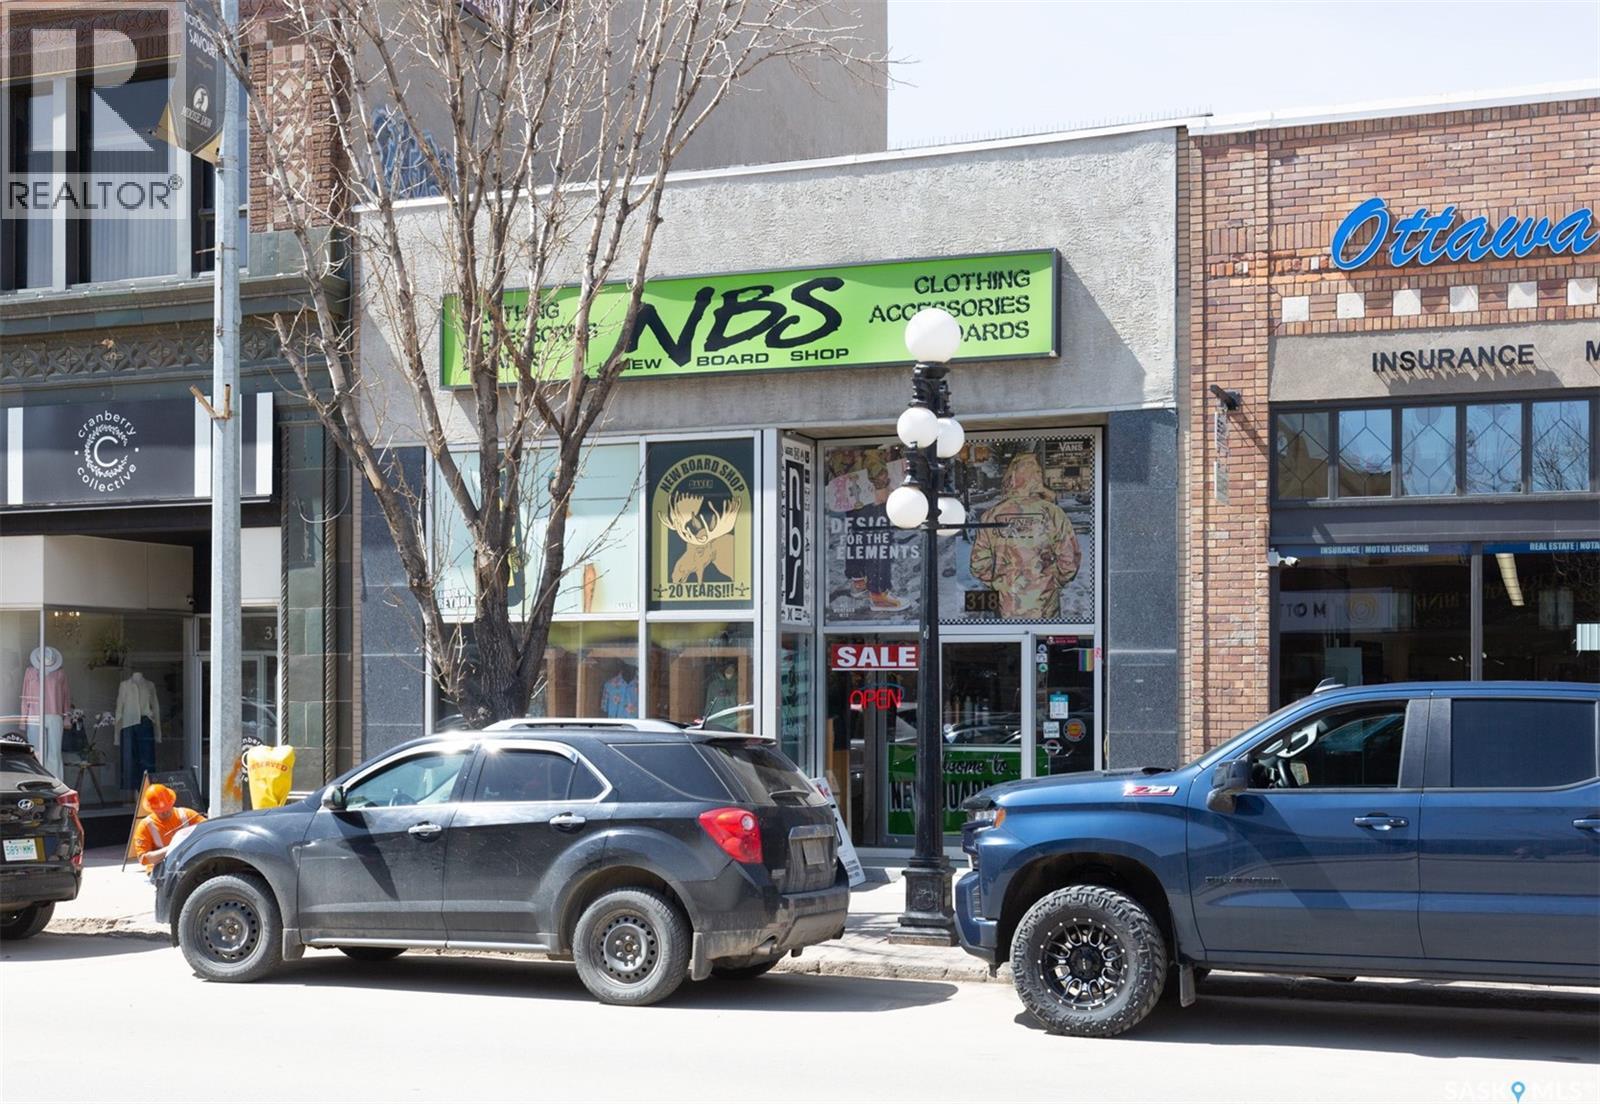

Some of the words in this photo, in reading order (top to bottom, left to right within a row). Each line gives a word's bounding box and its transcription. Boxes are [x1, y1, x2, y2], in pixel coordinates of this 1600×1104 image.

[1331, 197, 1600, 270] Ottawa
[914, 269, 1031, 295] CLOTHING
[868, 295, 1031, 324] ACCSORIES
[621, 277, 844, 367] NBS
[957, 320, 1030, 342] ARDS
[696, 353, 769, 367] BOARD
[790, 348, 849, 362] SHOP
[1371, 343, 1536, 373] INSURANCE
[78, 410, 136, 438] cranberry
[77, 464, 137, 492] collective
[660, 467, 683, 494] NEW
[681, 458, 720, 475] BOARD
[719, 464, 745, 493] SHOP
[830, 516, 889, 534] DESIG
[840, 535, 863, 545] FOR
[867, 532, 891, 544] THE
[1529, 542, 1548, 551] REAL
[1548, 541, 1575, 551] ESTATE
[836, 545, 920, 560] ELEMENTS
[1320, 545, 1360, 555] INSURANCE
[1365, 545, 1391, 554] MOTOR
[668, 584, 683, 599] 20
[685, 583, 734, 599] YEARS!!!
[966, 592, 998, 611] 318
[837, 646, 917, 668] SALE
[849, 688, 902, 709] OPEN
